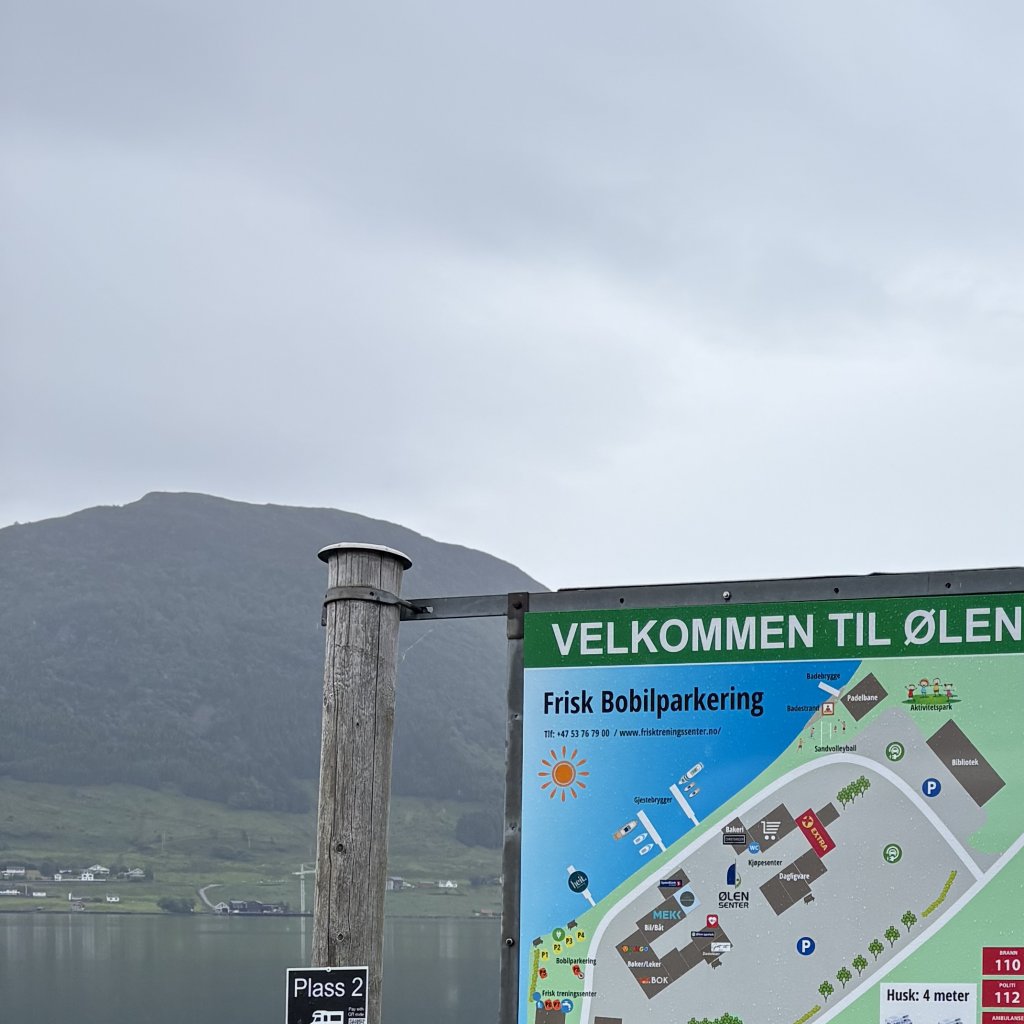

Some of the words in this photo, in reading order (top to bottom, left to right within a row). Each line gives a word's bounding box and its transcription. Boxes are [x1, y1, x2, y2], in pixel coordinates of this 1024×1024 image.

[552, 614, 814, 656] VELKOMMEN
[828, 612, 891, 647] TIL
[904, 606, 1022, 645] ØLEN
[806, 672, 841, 680] Badebrygge
[544, 690, 594, 714] Frisk
[601, 686, 764, 719] Bobilparkering
[847, 694, 878, 702] Padelbane
[787, 704, 820, 712] Badestrand
[910, 703, 953, 712] Aktivitetspark
[557, 730, 569, 738] +47
[570, 730, 579, 738] 53
[581, 729, 589, 737] 76
[591, 729, 600, 737] 79
[601, 729, 610, 737] 00
[619, 727, 722, 737] www.frisktreningssenter.no/
[952, 758, 979, 767] Bibliotek
[927, 782, 936, 795] P
[810, 828, 828, 851] EXTRA
[779, 873, 810, 881] Dagligvare
[718, 891, 749, 901] ØLEN
[801, 940, 811, 953] P
[556, 958, 597, 966] Bobilparkering
[995, 959, 1021, 971] 110
[294, 977, 345, 998] Plass
[351, 977, 363, 997] 2
[556, 990, 597, 998] treningssenter
[887, 989, 919, 1001] Husk:
[922, 989, 930, 1001] 4
[934, 990, 970, 1002] meter
[994, 991, 1021, 1004] 112
